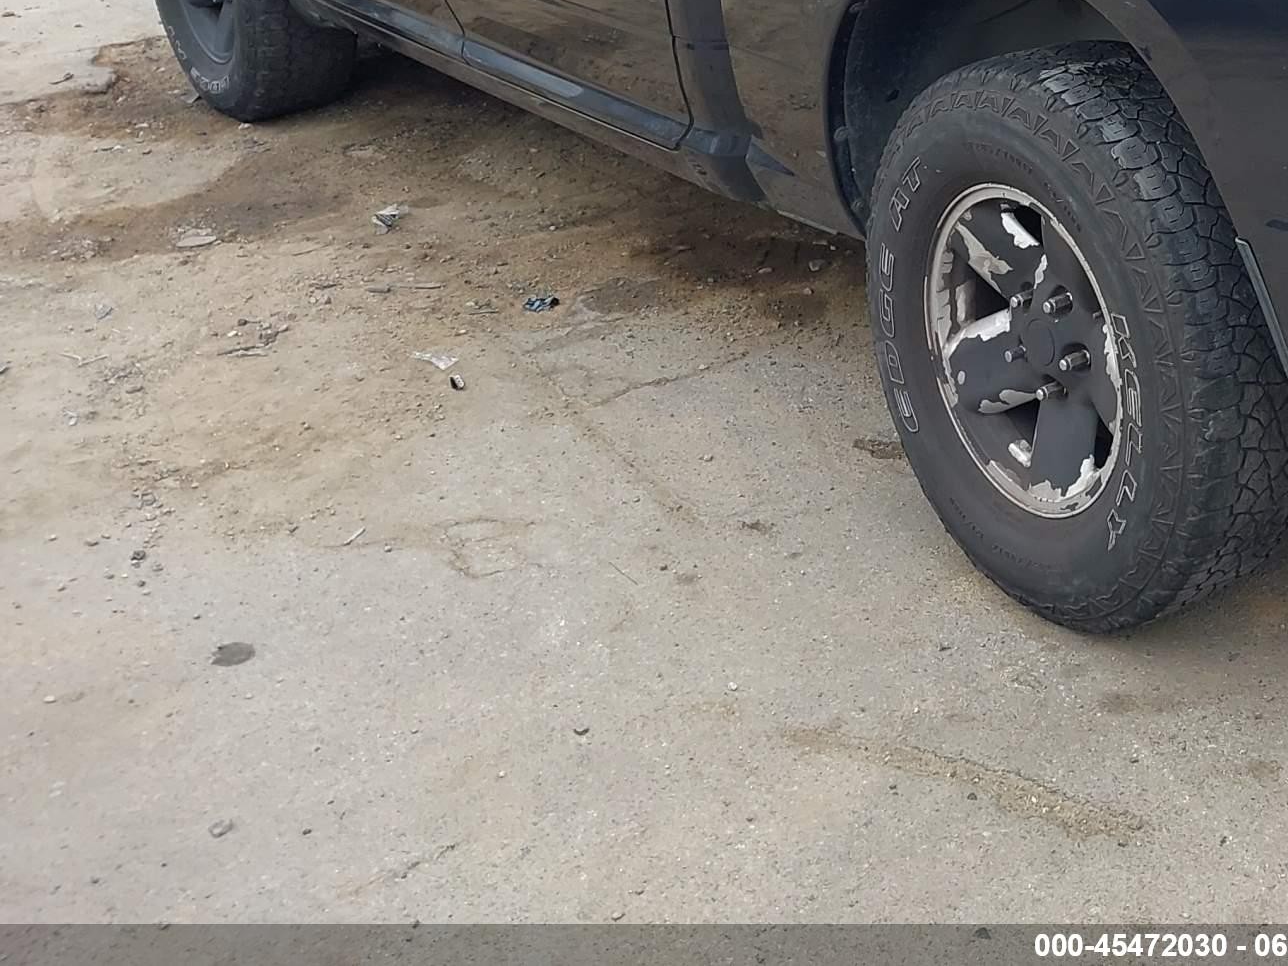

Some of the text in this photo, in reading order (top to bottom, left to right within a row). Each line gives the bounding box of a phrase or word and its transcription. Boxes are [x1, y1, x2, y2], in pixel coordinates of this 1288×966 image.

[880, 156, 922, 434] EDGE AT
[1110, 312, 1144, 553] KELLY
